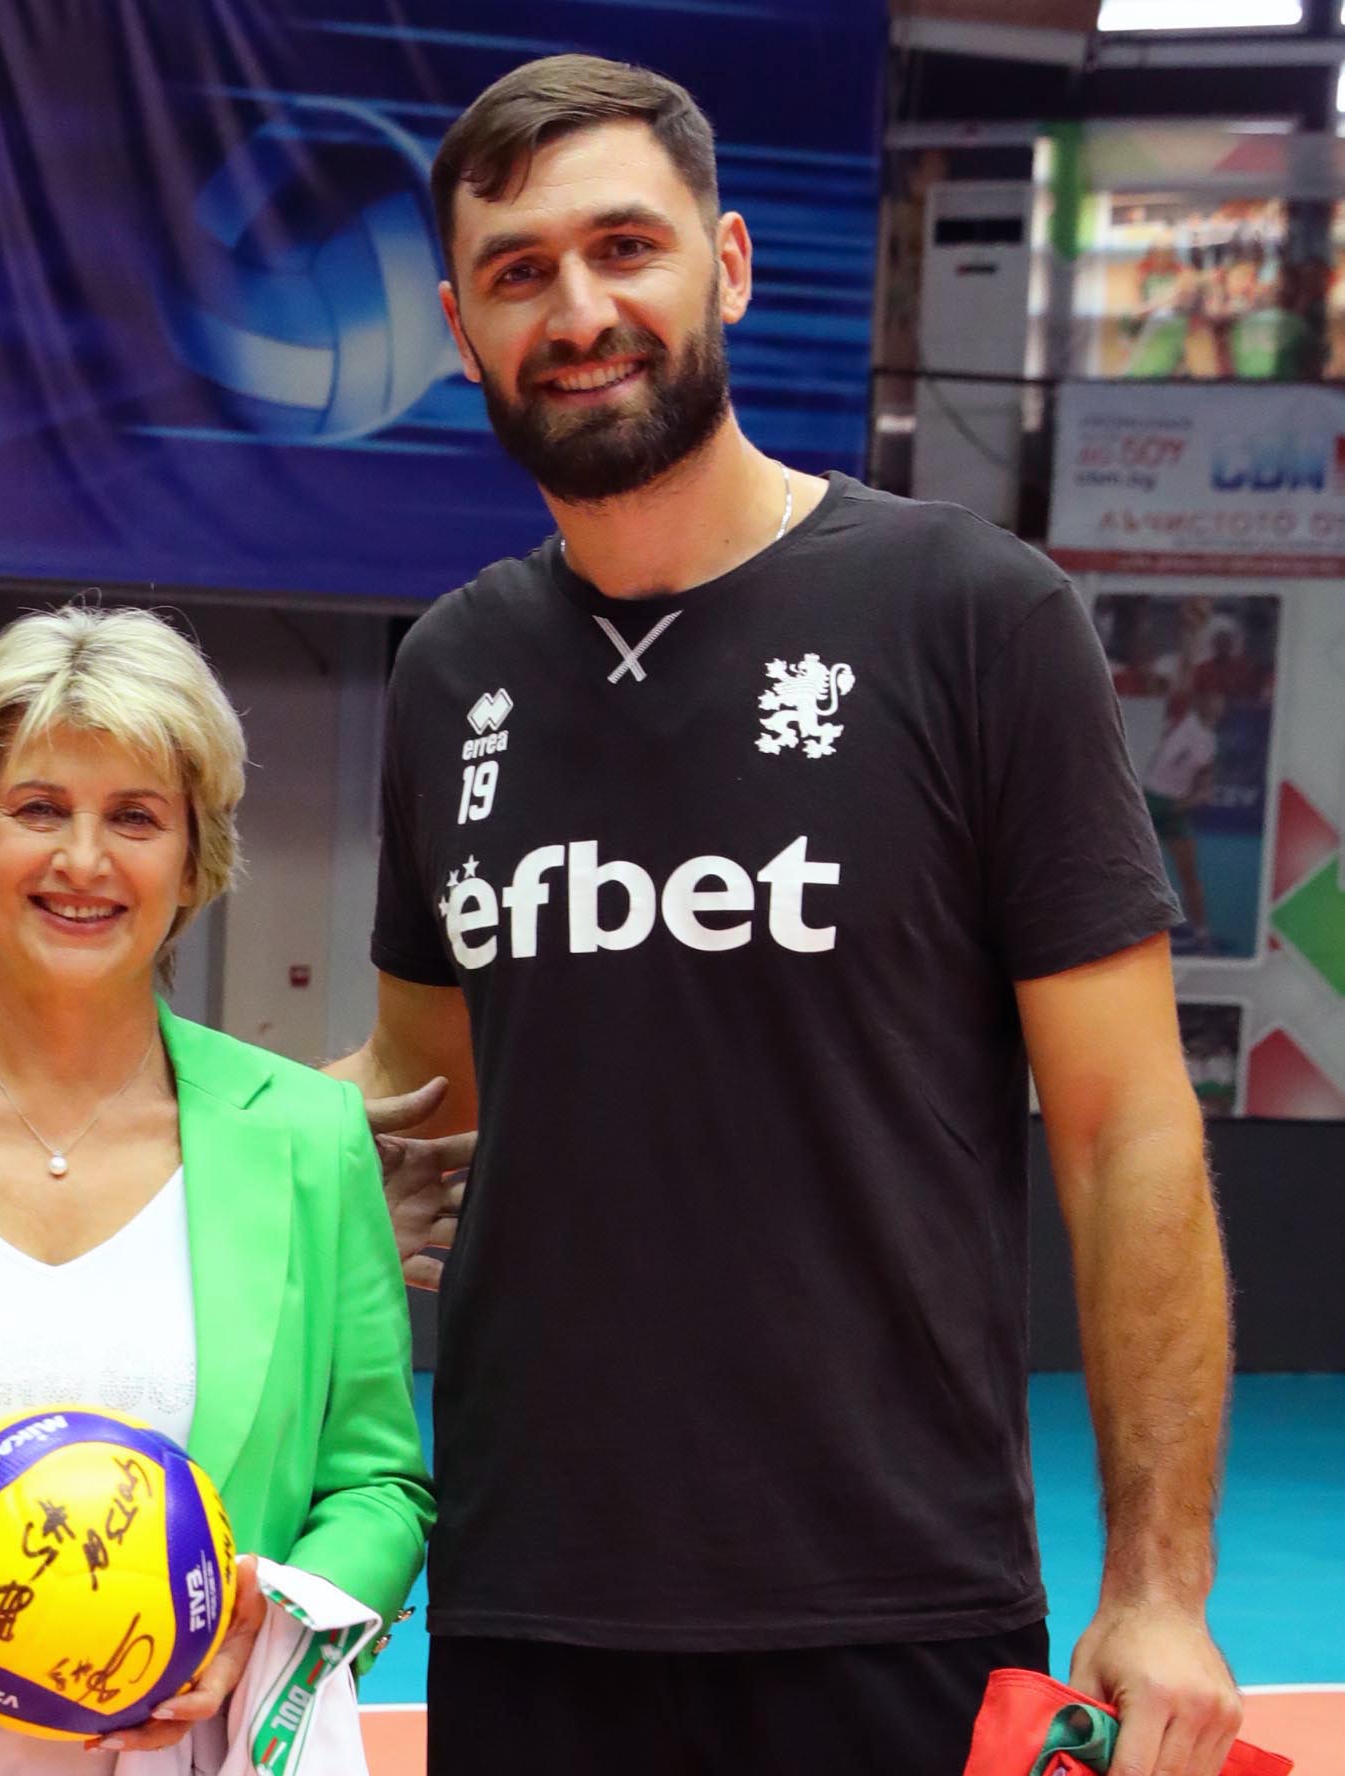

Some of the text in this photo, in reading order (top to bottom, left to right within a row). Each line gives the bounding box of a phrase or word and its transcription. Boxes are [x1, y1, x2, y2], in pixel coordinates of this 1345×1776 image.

[457, 760, 499, 825] 19
[446, 835, 841, 970] efbet
[185, 1563, 207, 1633] FIVB
[271, 1684, 317, 1732] BUL
